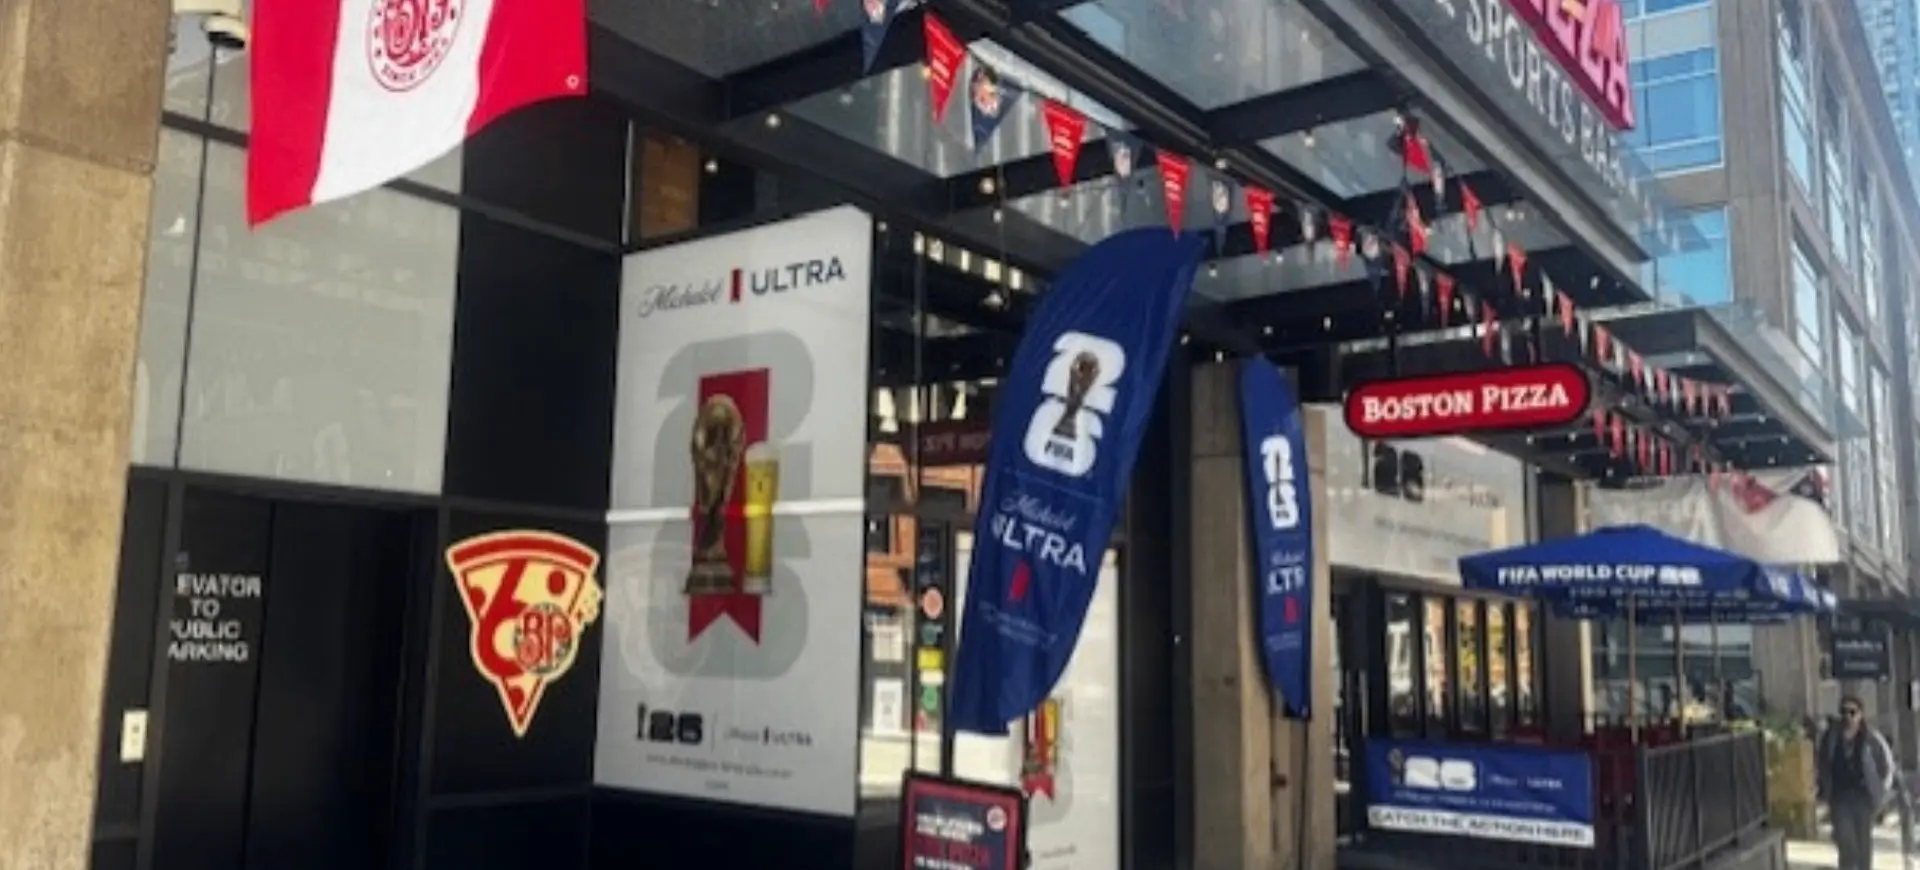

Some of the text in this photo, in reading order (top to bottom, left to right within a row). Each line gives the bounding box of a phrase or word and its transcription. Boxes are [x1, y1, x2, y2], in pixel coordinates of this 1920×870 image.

[1465, 0, 1576, 144] SPORTS
[751, 256, 846, 295] ULTRA
[1361, 382, 1570, 424] BOSTON PIZZA
[177, 573, 262, 598] EVATOR
[1497, 566, 1538, 586] FIFA
[1539, 563, 1613, 583] WORLD
[1615, 562, 1656, 581] CUP
[191, 598, 220, 618] TO
[168, 640, 249, 662] ARKING
[1371, 809, 1587, 843] CATCH THE ACTION HERE
